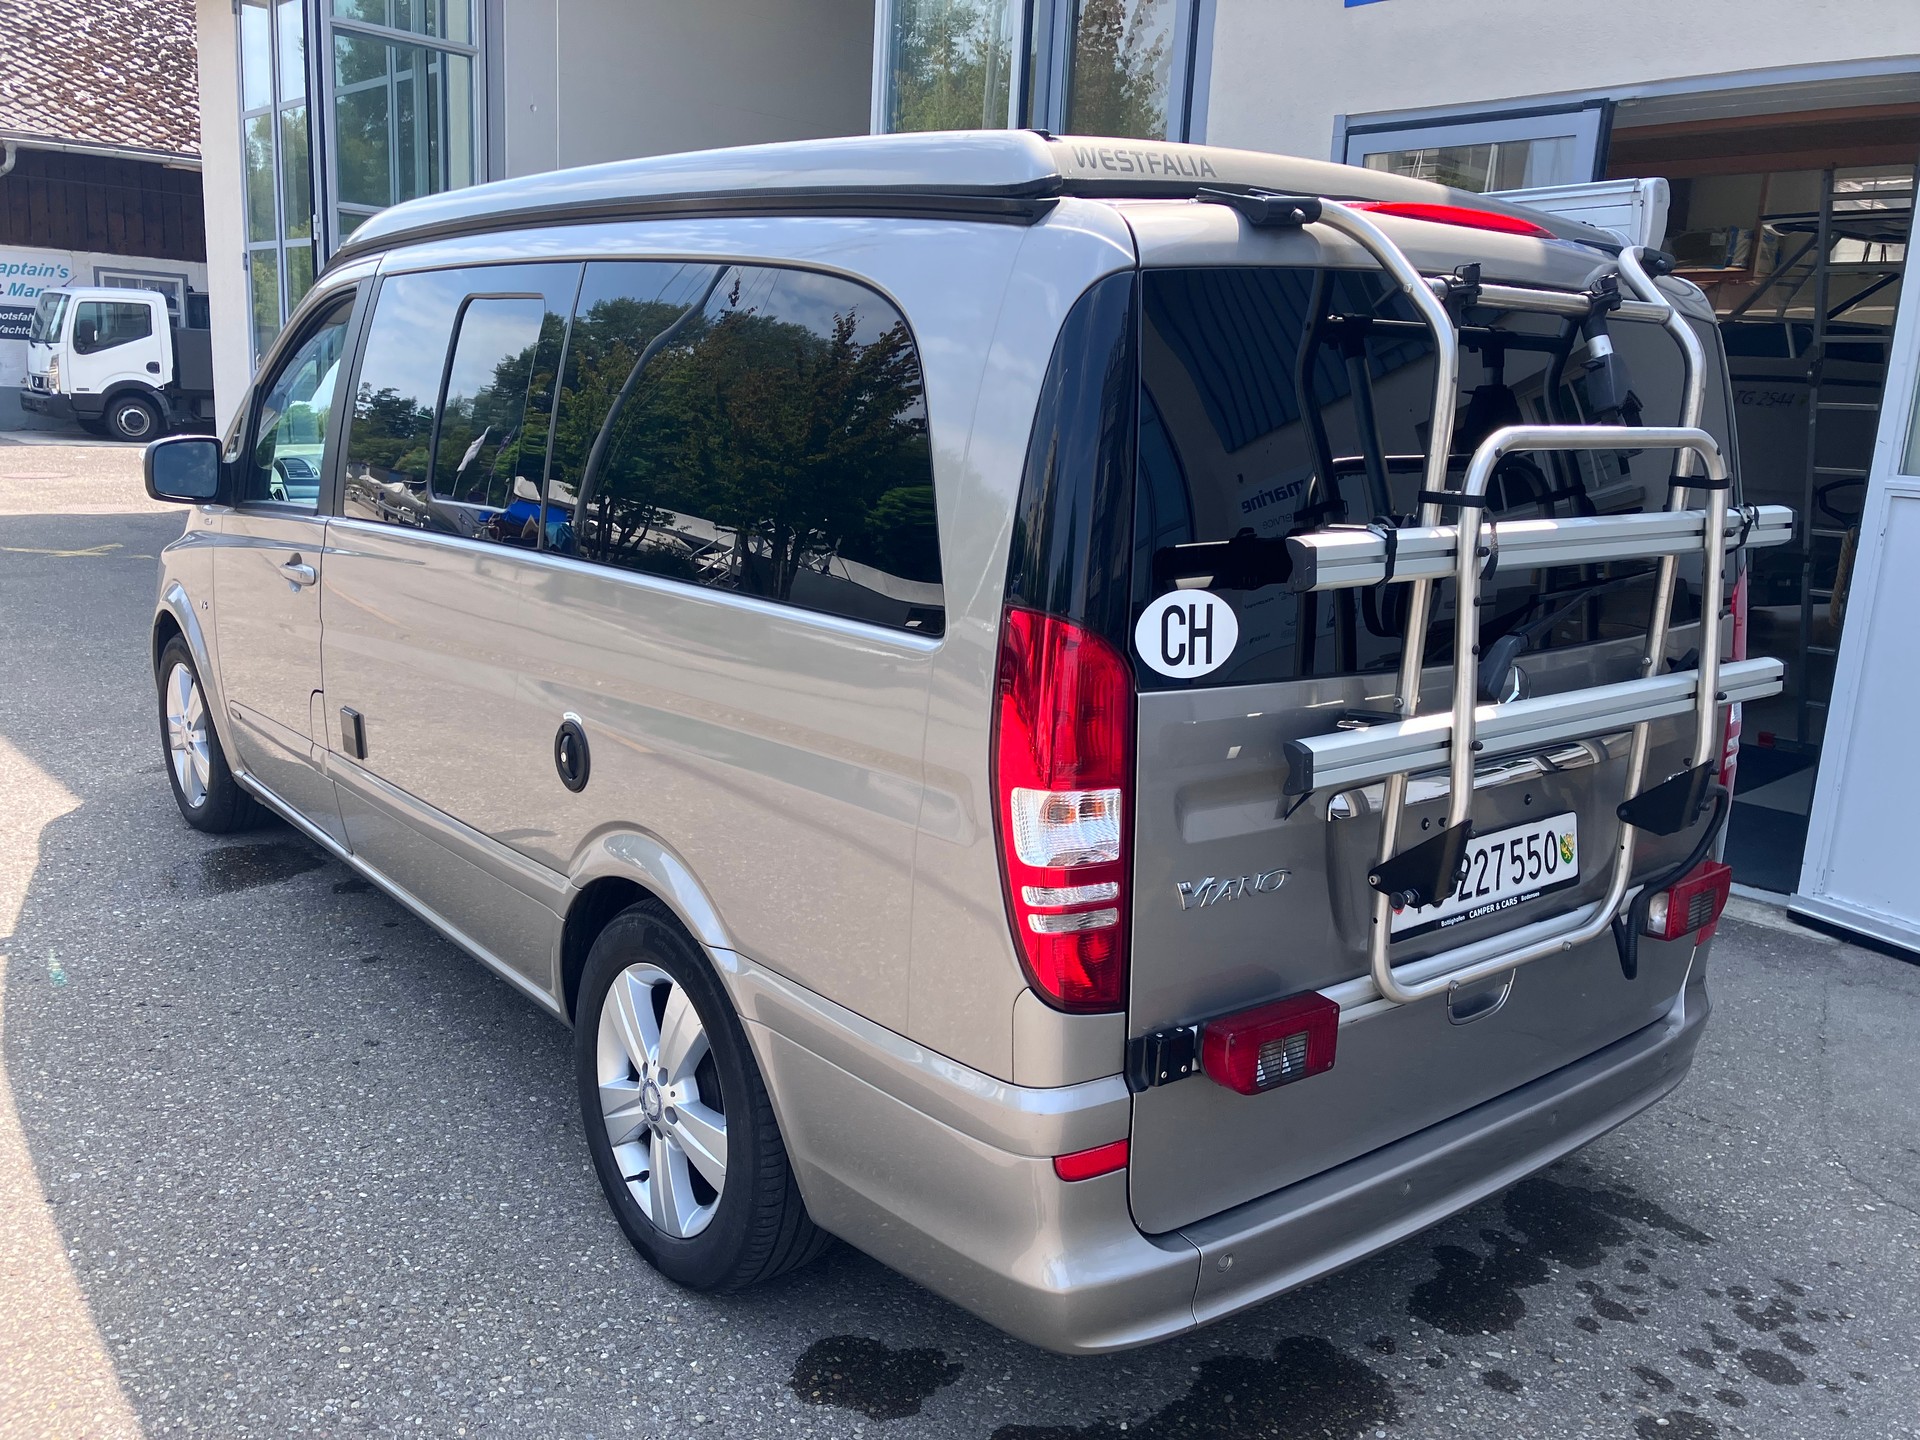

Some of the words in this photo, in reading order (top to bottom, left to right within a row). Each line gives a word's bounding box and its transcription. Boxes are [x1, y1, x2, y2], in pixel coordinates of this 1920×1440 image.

[1072, 146, 1218, 178] WESTFALIA
[0, 262, 69, 279] aptain's
[7, 282, 50, 298] Mar
[0, 311, 33, 322] otsfah
[1161, 604, 1213, 667] CH
[1458, 830, 1558, 902] 227550
[1176, 868, 1292, 911] VIANO
[1469, 903, 1496, 919] CAMPER
[1501, 896, 1518, 909] CARS
